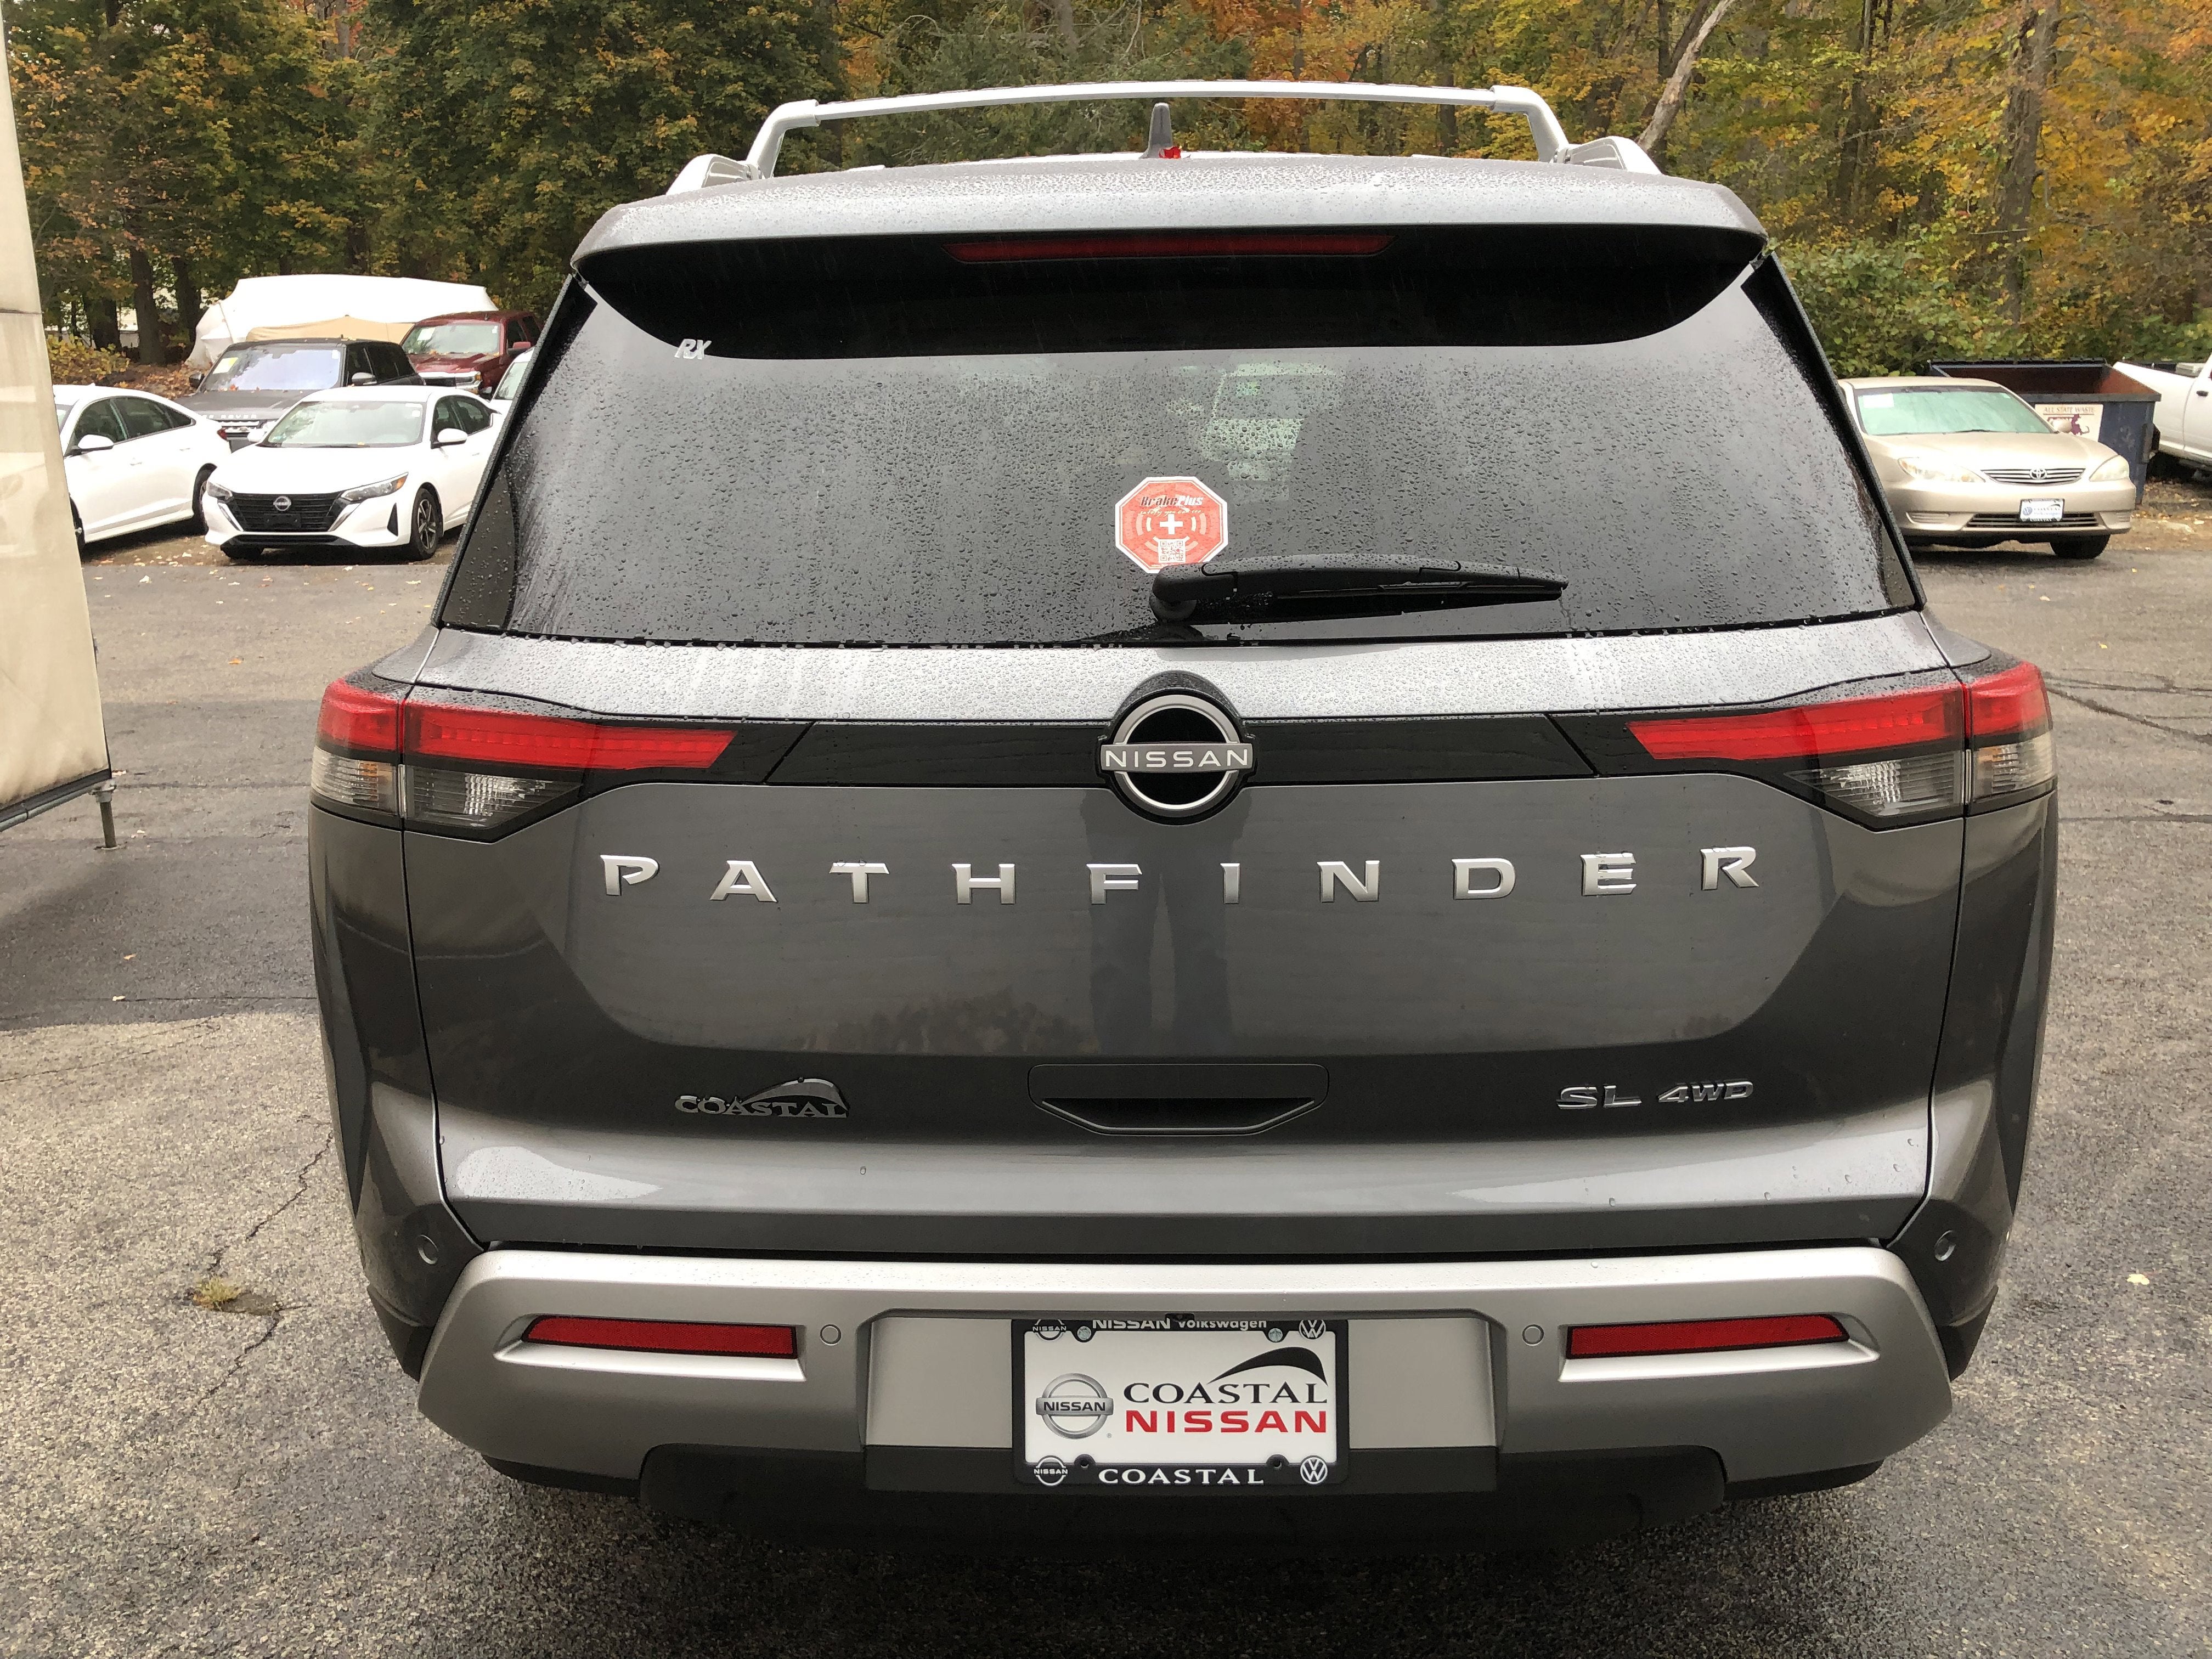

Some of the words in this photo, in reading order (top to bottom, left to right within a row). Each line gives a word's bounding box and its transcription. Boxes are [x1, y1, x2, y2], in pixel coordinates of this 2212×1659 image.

[1105, 749, 1248, 768] NISSAN
[600, 846, 1759, 905] PATHFINDER
[1556, 1085, 1642, 1109] SL
[1658, 1080, 1753, 1103] 4WD
[675, 1095, 848, 1118] COASTAL
[1092, 1318, 1171, 1329] NISSAN
[1124, 1381, 1328, 1404] COASTAL
[1043, 1401, 1106, 1412] NISSAN
[1126, 1410, 1327, 1433] NISSAN
[1098, 1468, 1264, 1484] COASTAL
